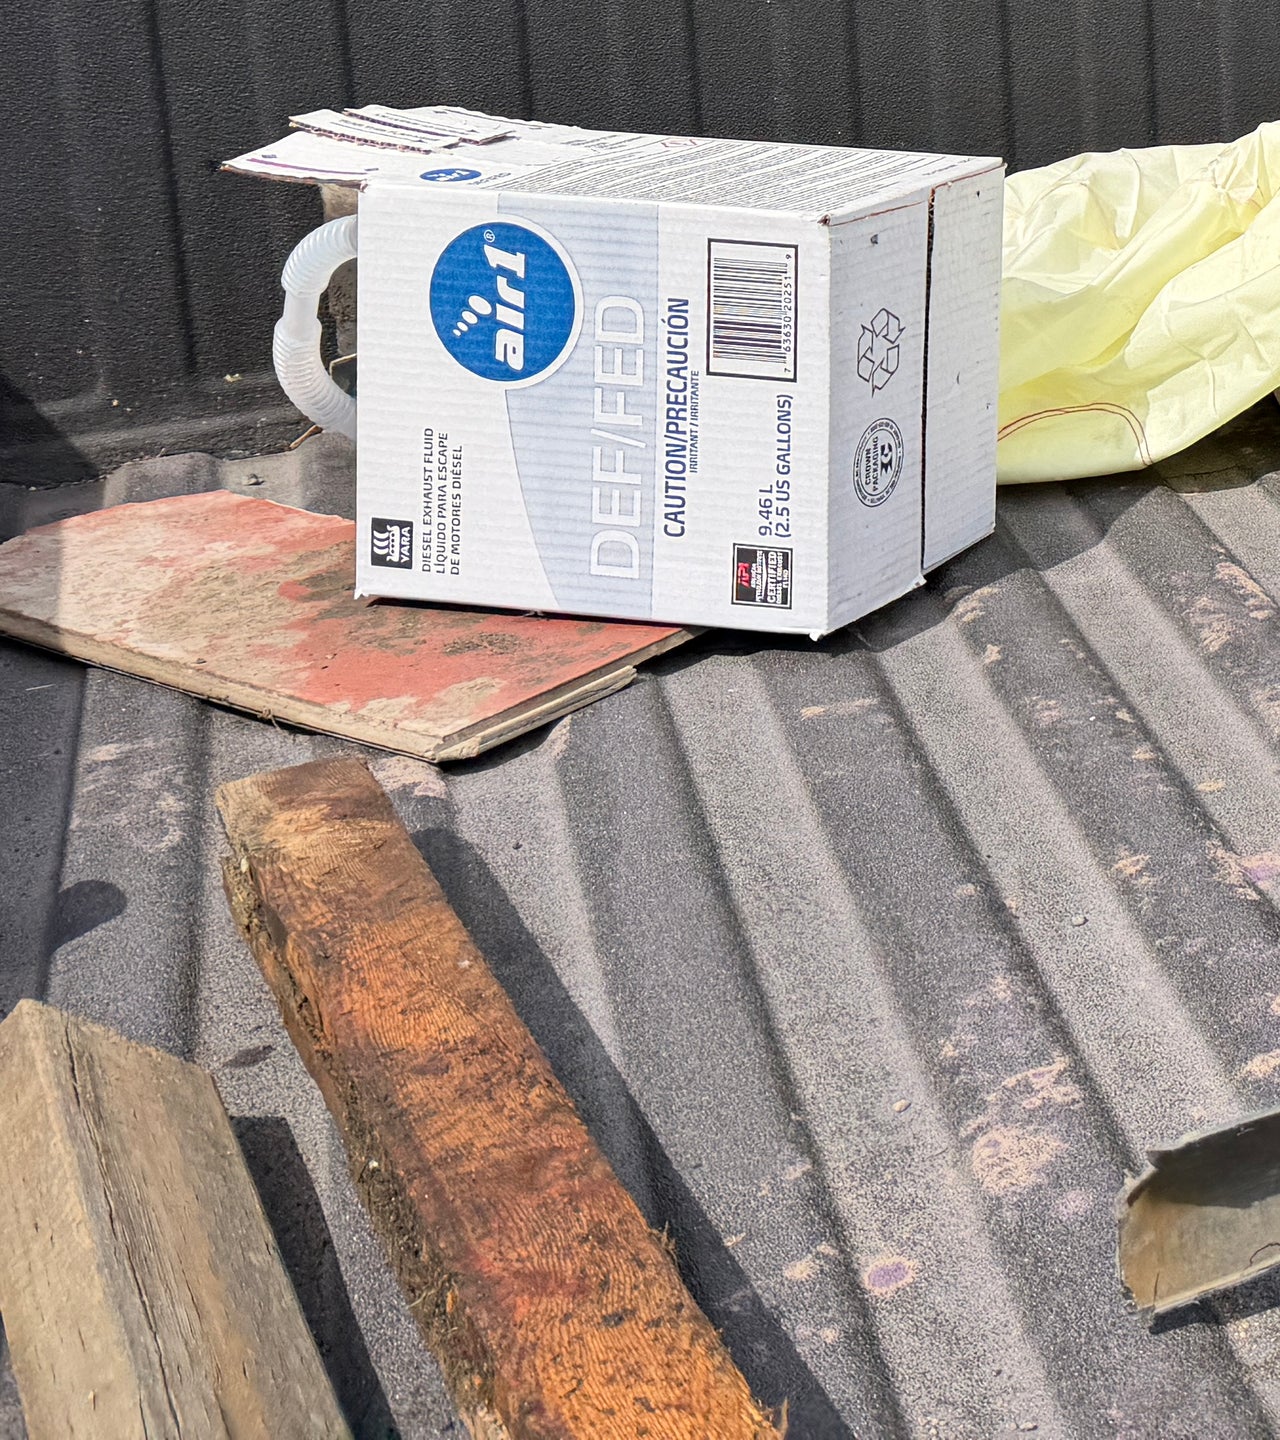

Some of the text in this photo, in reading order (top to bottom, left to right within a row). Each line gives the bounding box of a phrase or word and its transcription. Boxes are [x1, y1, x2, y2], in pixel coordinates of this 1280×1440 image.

[589, 295, 646, 579] DEF/FED
[661, 297, 690, 538] CAUTION/PRECAUCIÓN
[690, 370, 699, 421] IRRITANTE
[689, 428, 698, 473] IRRITANT
[759, 484, 773, 494] L
[775, 394, 794, 538] (2.5 US GALLONS)
[400, 526, 411, 563] YARA
[422, 427, 434, 573] DIESEL EXHAUST FLUID
[434, 432, 448, 574] LÍQUIDO PARA ESCAPE
[450, 445, 462, 575] DE MOTORES DIÉSEL
[758, 498, 772, 537] 9.46
[767, 551, 777, 603] CERTIFIED
